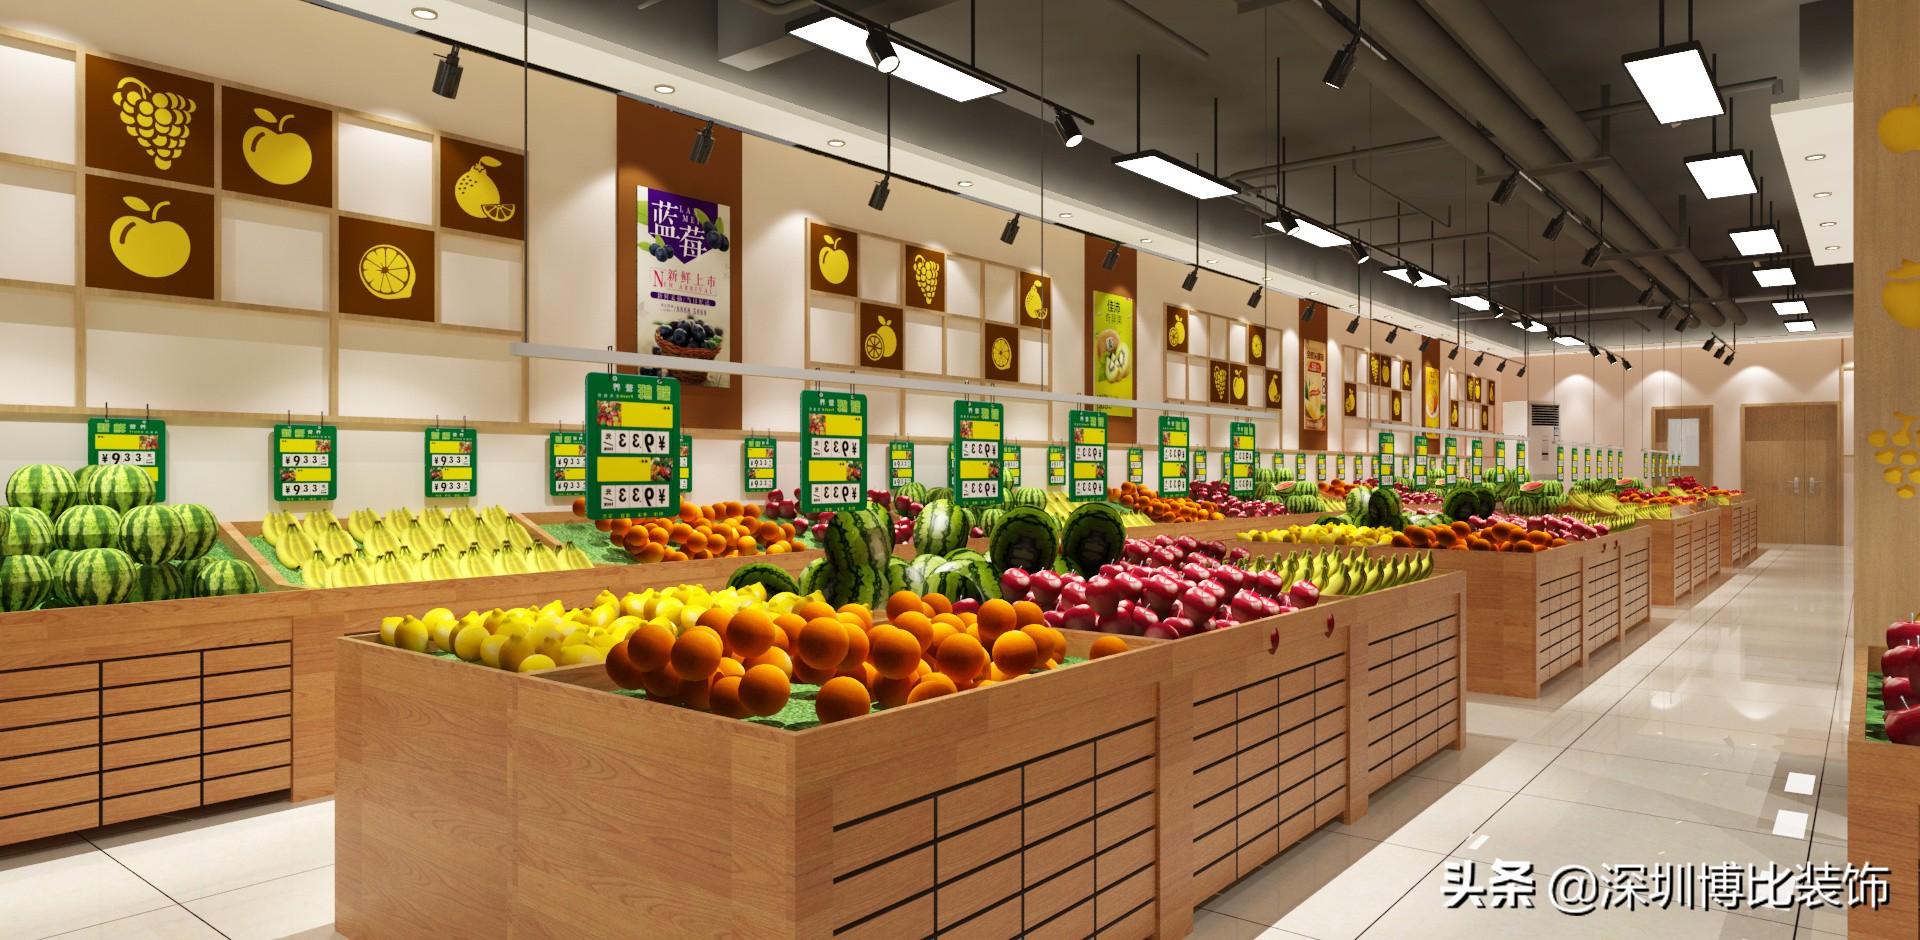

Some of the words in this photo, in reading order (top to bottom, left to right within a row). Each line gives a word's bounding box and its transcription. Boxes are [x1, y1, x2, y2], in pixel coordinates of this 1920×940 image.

[650, 200, 707, 257] 蓝莓
[667, 269, 716, 287] 新鲜上市
